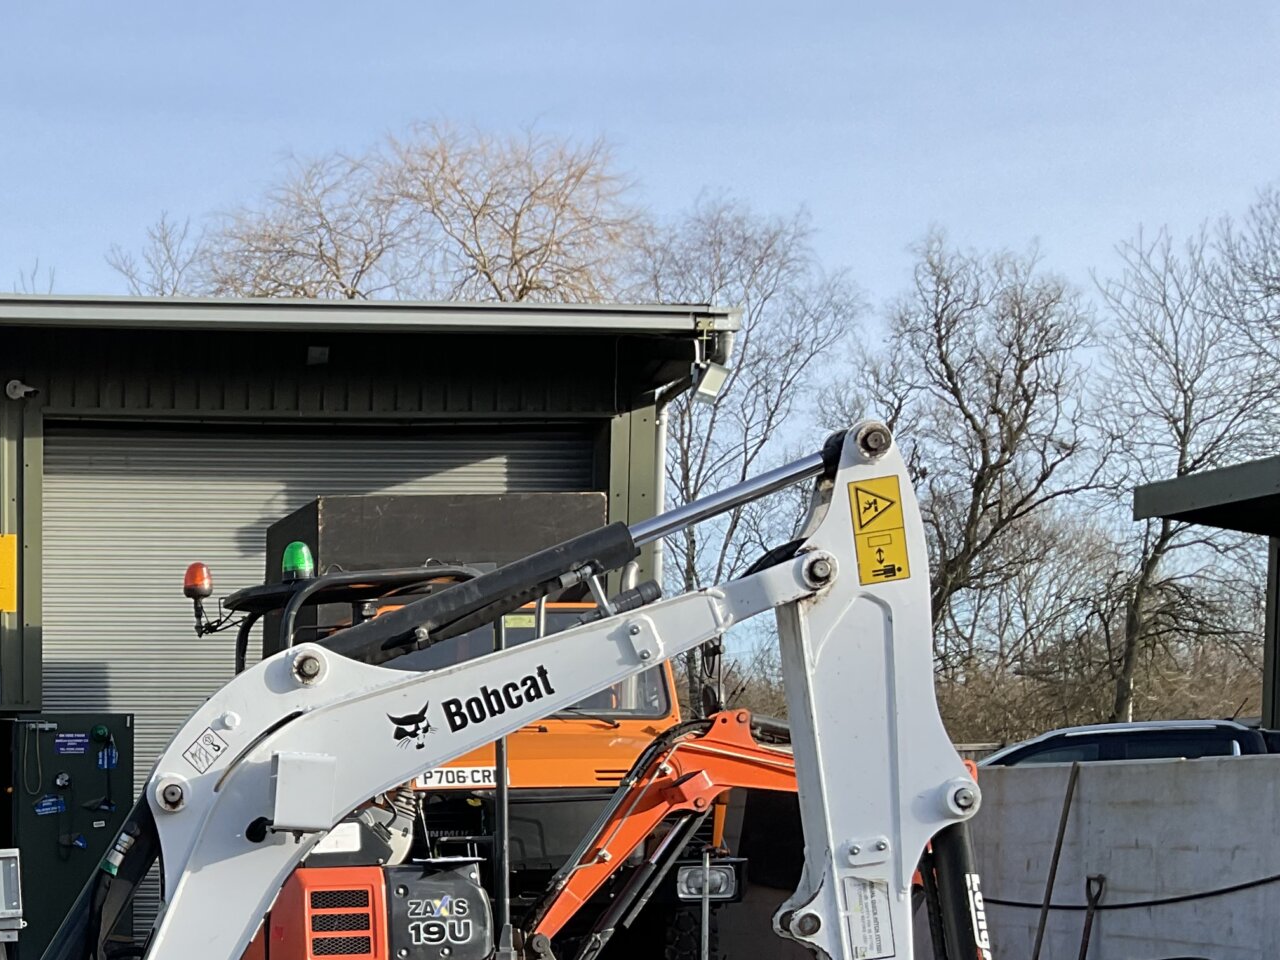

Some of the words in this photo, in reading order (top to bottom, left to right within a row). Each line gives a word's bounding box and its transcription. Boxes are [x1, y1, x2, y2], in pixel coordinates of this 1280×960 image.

[441, 665, 555, 732] Bobcat
[423, 770, 467, 785] P706
[408, 895, 468, 918] ZAXIS
[408, 920, 472, 945] 19U
